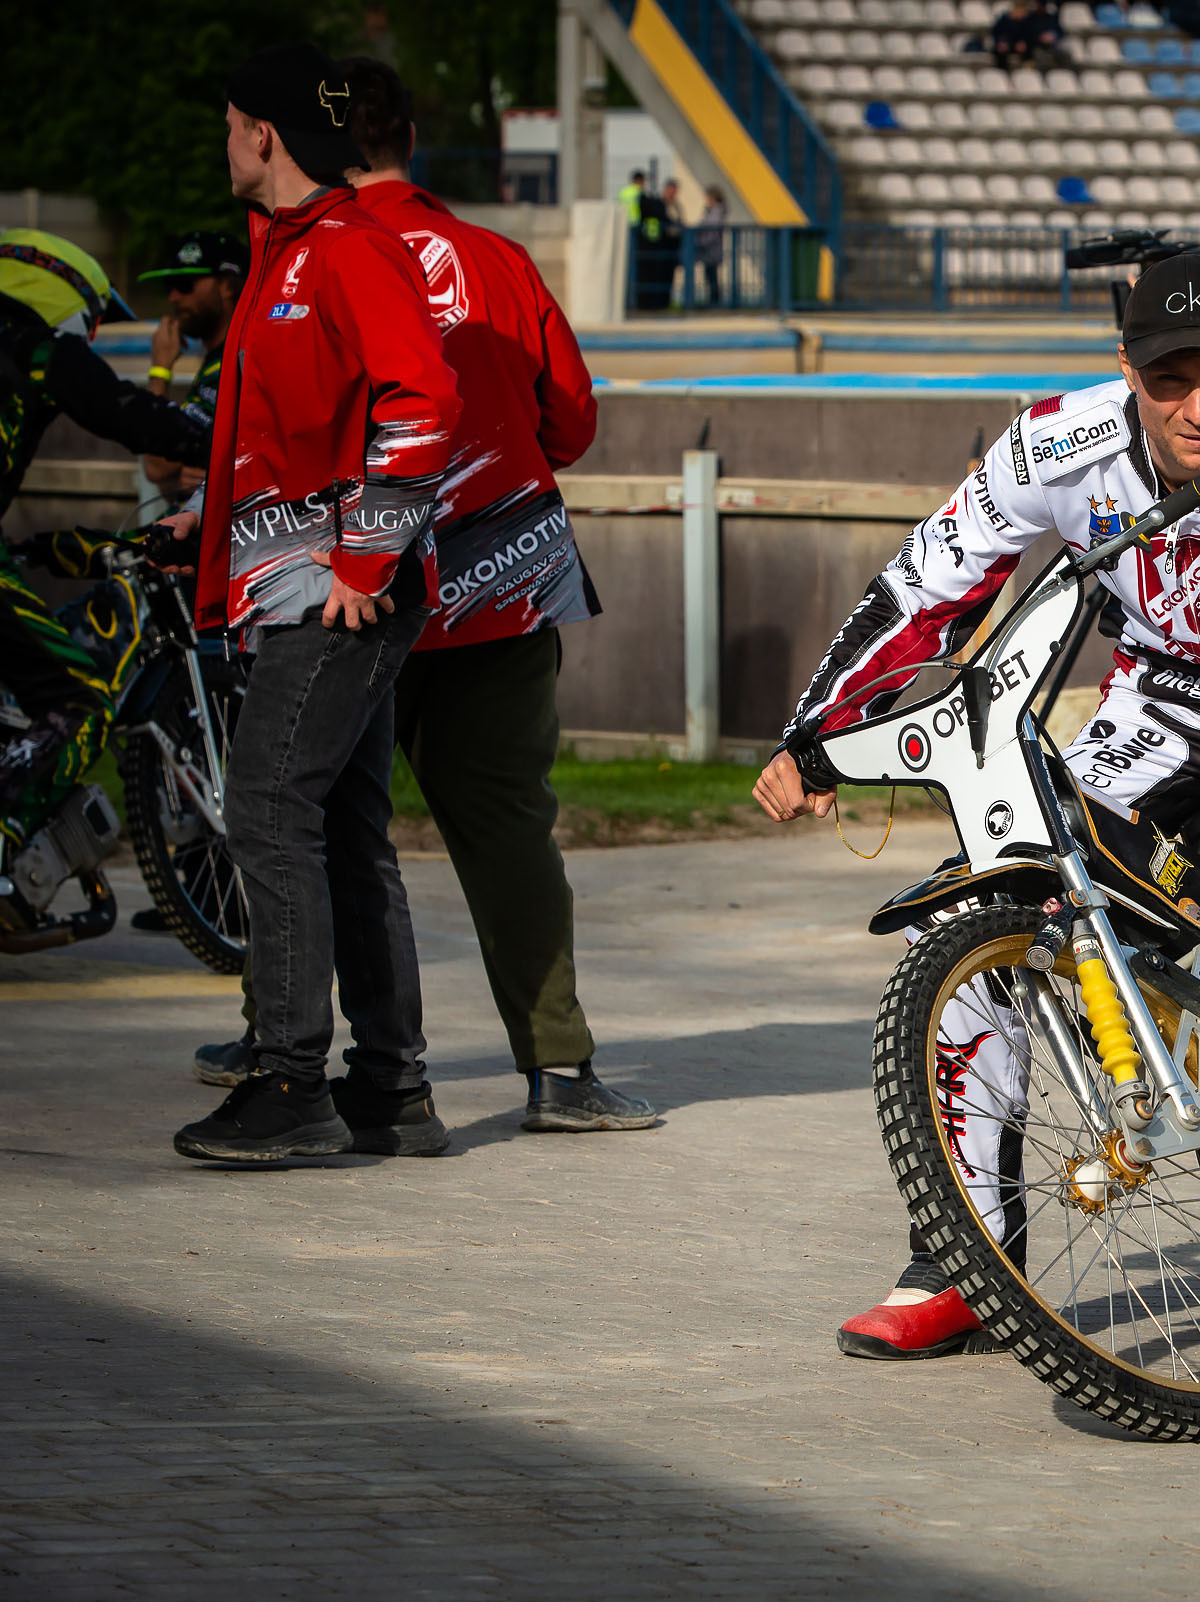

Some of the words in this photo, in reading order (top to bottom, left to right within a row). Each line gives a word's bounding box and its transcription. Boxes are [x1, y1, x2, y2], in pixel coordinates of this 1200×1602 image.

[423, 241, 441, 266] OTIV
[1032, 419, 1117, 463] SemiCom
[432, 505, 567, 615] OKOMOTIV
[494, 575, 548, 612] SPEEDWAY
[548, 559, 570, 578] CLUB
[495, 544, 568, 597] DAUGAVPILS
[932, 650, 1031, 738] OPBET
